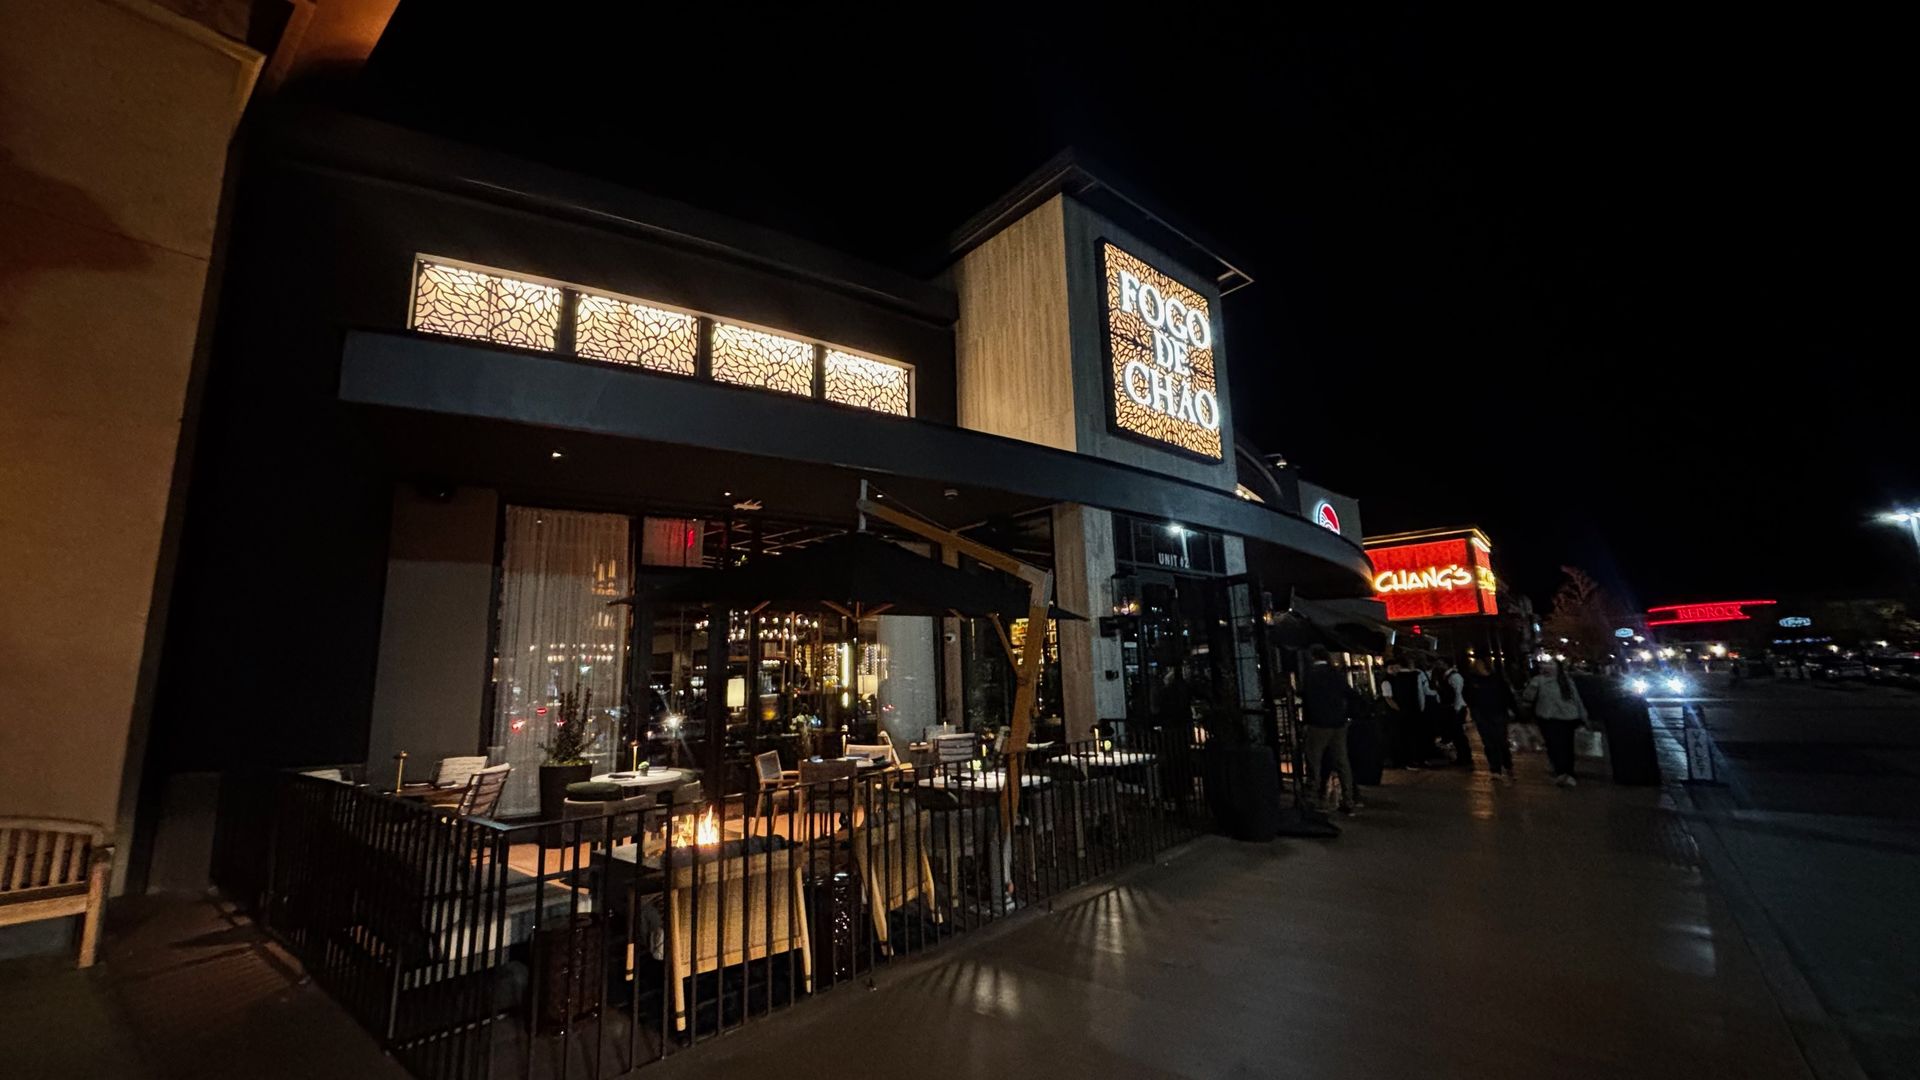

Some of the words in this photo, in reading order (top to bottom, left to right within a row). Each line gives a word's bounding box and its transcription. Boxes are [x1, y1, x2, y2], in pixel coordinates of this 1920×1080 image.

[1119, 270, 1211, 349] FOGO
[1153, 331, 1191, 376] DE
[1158, 552, 1178, 567] UNIT
[1374, 564, 1472, 592] CHANG'S
